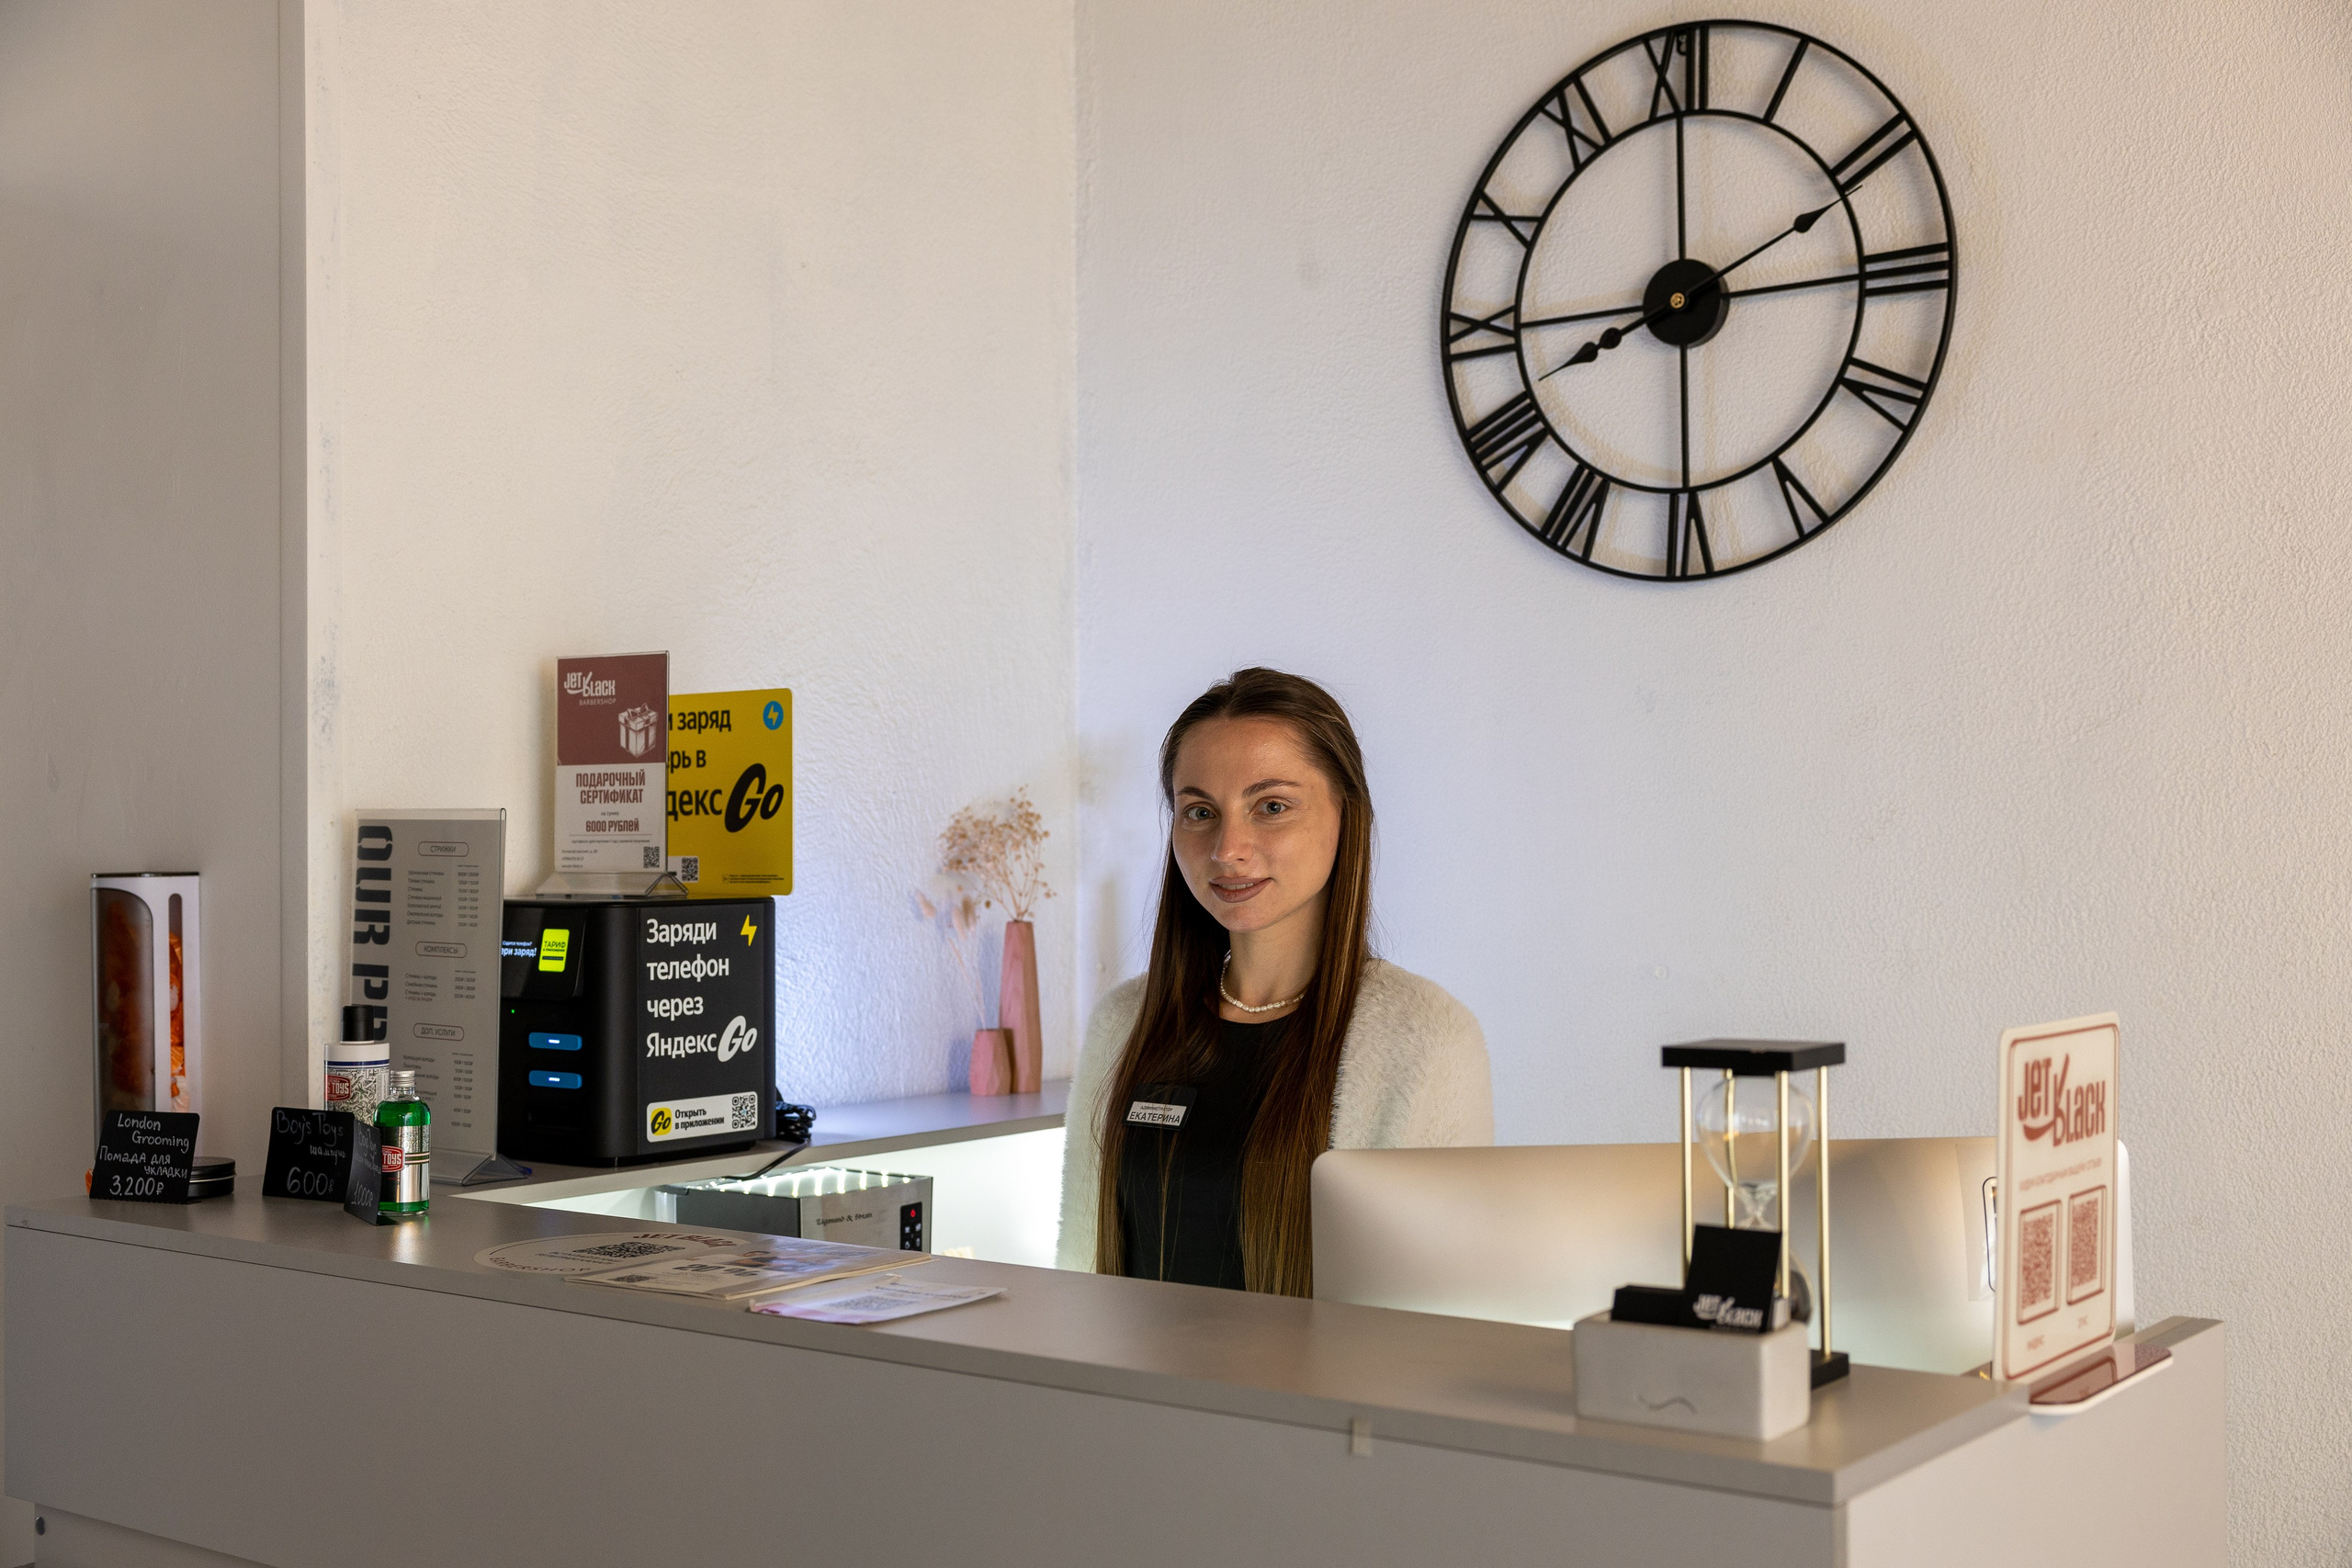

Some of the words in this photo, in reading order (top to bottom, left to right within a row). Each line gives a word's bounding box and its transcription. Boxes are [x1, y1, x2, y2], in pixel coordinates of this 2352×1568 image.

[677, 710, 731, 734] заряд
[696, 750, 707, 768] в
[576, 769, 645, 789] ПОДАРОЧНЫЙ
[580, 789, 644, 804] СЕРТИФИКАТ
[725, 763, 784, 833] Go
[585, 820, 606, 832] 6000
[430, 845, 457, 853] СТРИЖКИ
[354, 826, 393, 945] OUR
[647, 919, 717, 947] Заряди
[424, 945, 458, 953] КОМПЛЕКСЫ
[514, 947, 537, 957] заряд!
[647, 953, 729, 982] телефон
[647, 997, 704, 1021] через
[647, 1032, 717, 1059] Яндекс
[718, 1015, 758, 1063] Go
[118, 1113, 161, 1132] London
[650, 1110, 672, 1134] Go
[674, 1109, 707, 1120] Открыть
[680, 1117, 725, 1131] приложении
[1129, 1111, 1181, 1123] ЕКАТЕРИНА
[277, 1110, 311, 1145] Boy's
[312, 1111, 344, 1146] Toys
[131, 1130, 189, 1154] Grooming
[150, 1154, 171, 1165] для
